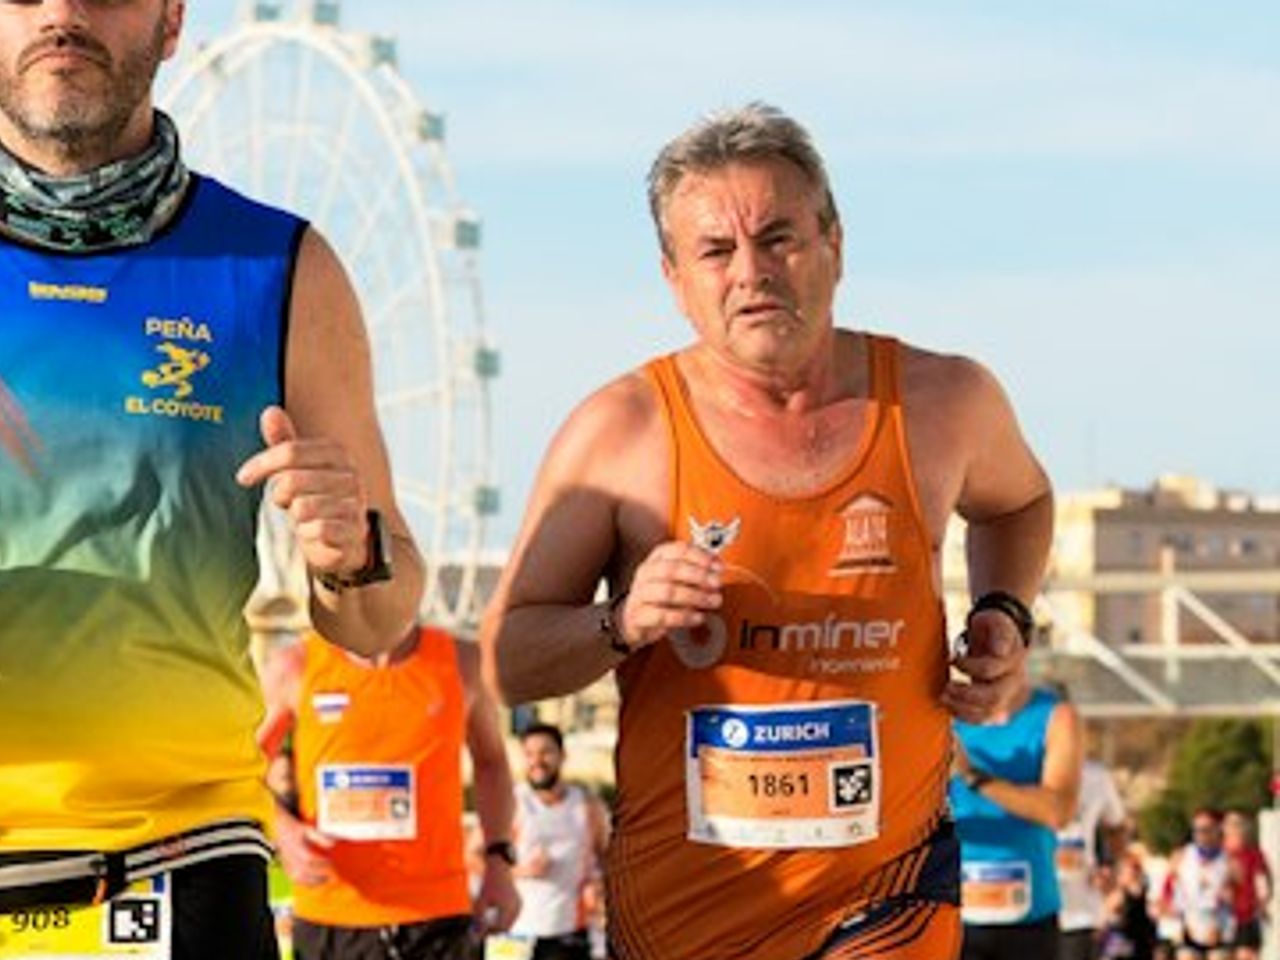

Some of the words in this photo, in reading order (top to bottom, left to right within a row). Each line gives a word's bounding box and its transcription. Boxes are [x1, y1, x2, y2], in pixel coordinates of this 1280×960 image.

[144, 316, 212, 342] PEÑA
[125, 396, 150, 414] EL
[152, 398, 223, 422] COYOTE
[754, 721, 831, 743] ZURICH
[748, 772, 810, 798] 1861
[11, 905, 72, 933] 908
